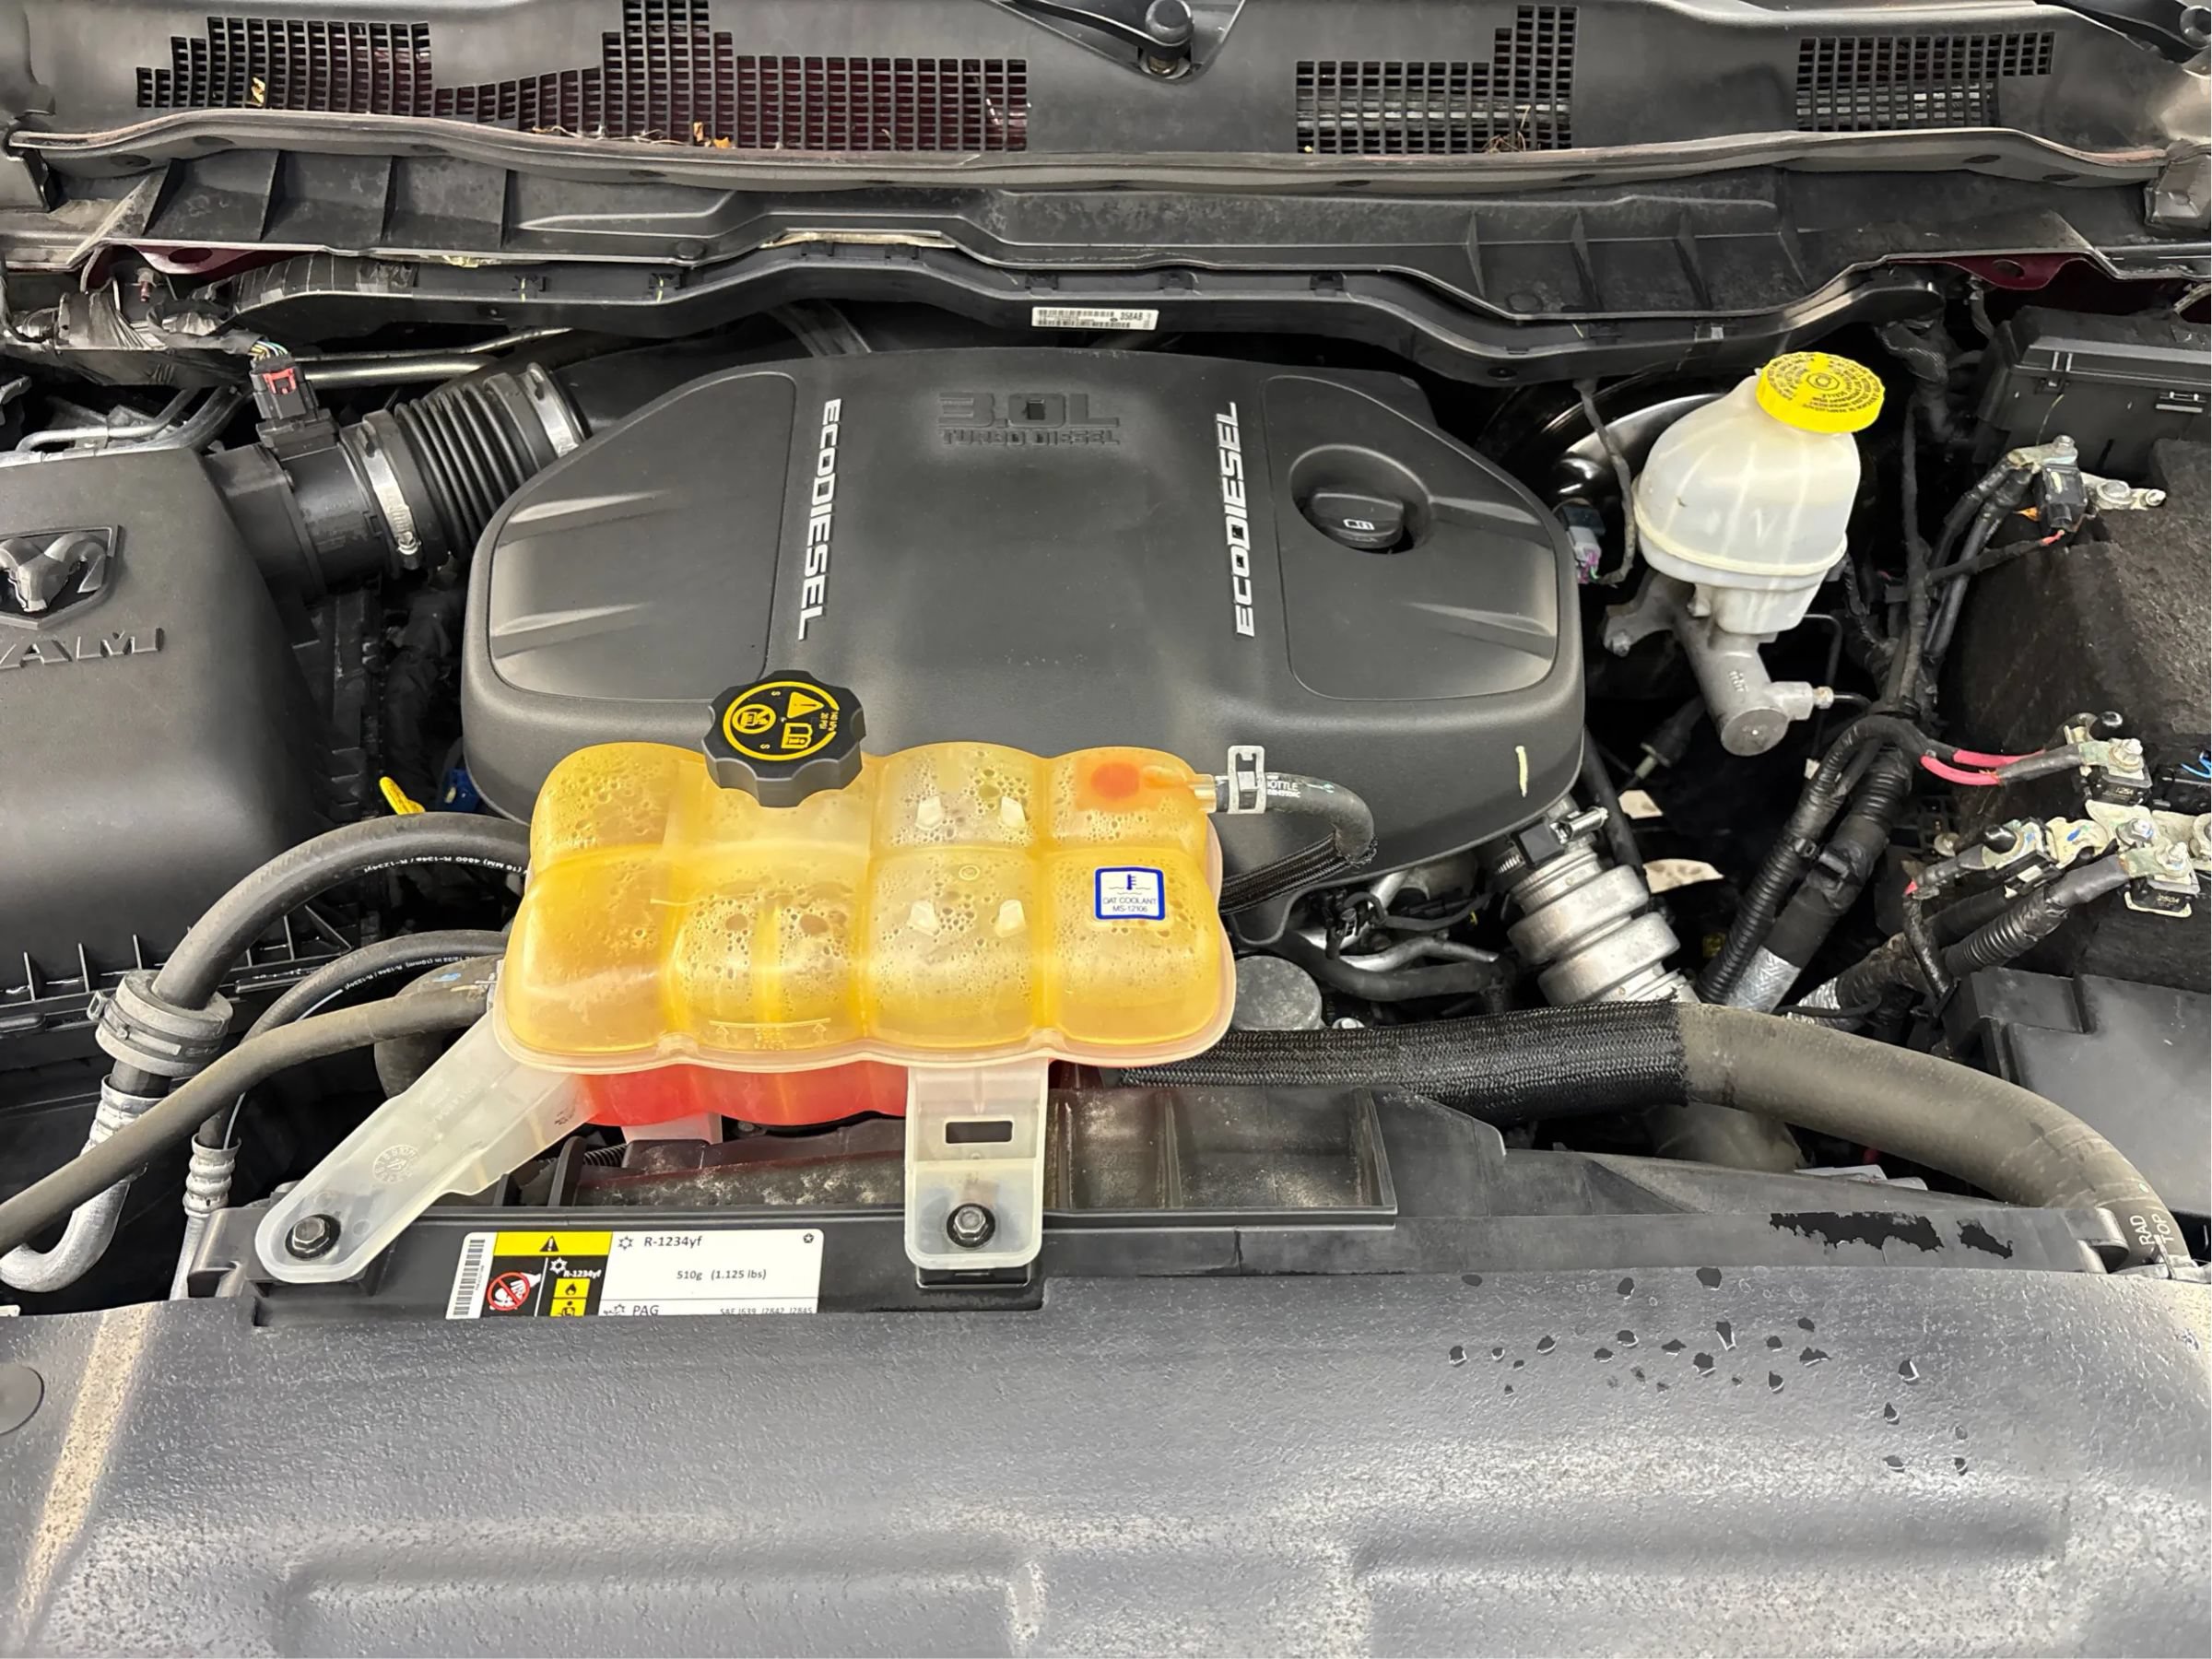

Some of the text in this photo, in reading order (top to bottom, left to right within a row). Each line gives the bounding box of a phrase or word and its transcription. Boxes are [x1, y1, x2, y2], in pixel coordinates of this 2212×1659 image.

[939, 393, 1120, 428] 3.0L
[942, 429, 1120, 445] TURBO DIESEL
[798, 398, 842, 641] ECODIESEL
[1216, 401, 1255, 638] ECODIESEL
[363, 858, 408, 874] R-1234yf
[1119, 897, 1157, 905] COOLANT
[406, 958, 433, 968] (10mm)
[2129, 1215, 2156, 1245] RAD
[2151, 1213, 2174, 1244] TOP
[643, 1236, 702, 1249] R-1234yf
[563, 1269, 602, 1279] R-1234yf
[676, 1268, 767, 1281] 510g (1.125 lbs)
[632, 1304, 659, 1316] PAG
